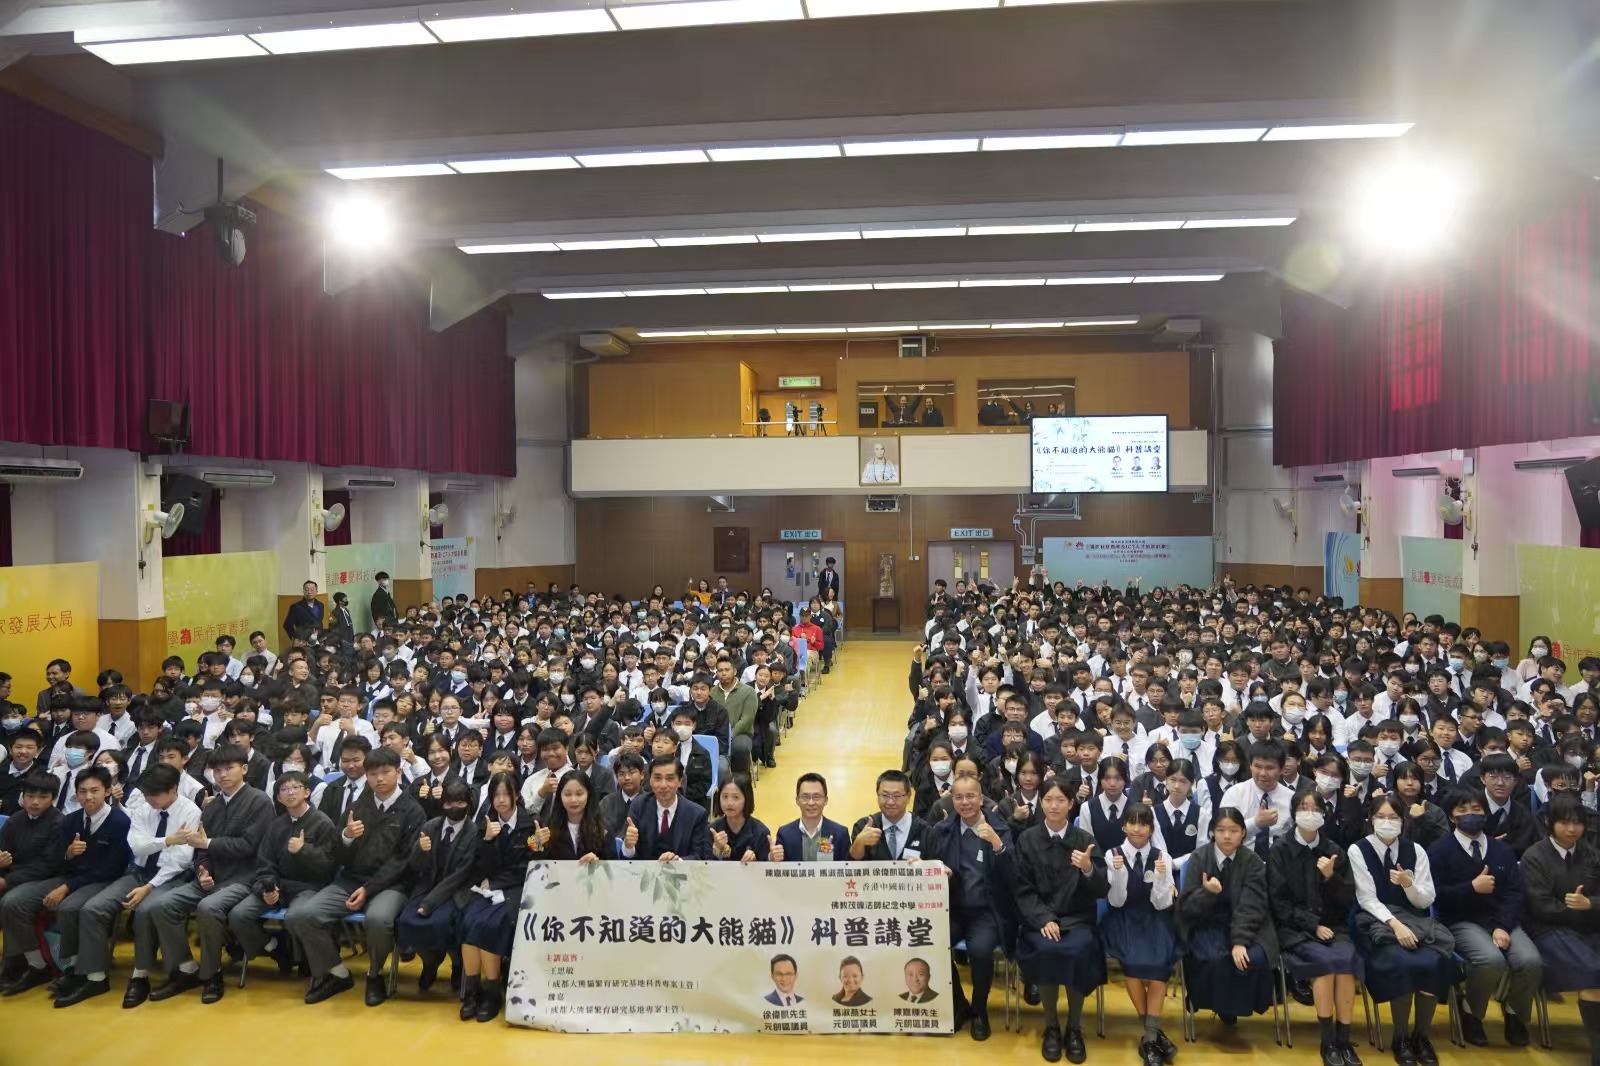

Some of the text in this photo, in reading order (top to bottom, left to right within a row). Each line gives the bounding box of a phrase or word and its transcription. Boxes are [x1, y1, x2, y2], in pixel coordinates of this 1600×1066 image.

[862, 882, 923, 891] 香港中國旅行社
[523, 912, 935, 948] 《你不知道的大熊貓》 科普講堂
[764, 1022, 809, 1031] 元朗區議員
[833, 1019, 878, 1029] 元朗區議員
[895, 1019, 940, 1029] 元朗區議員
